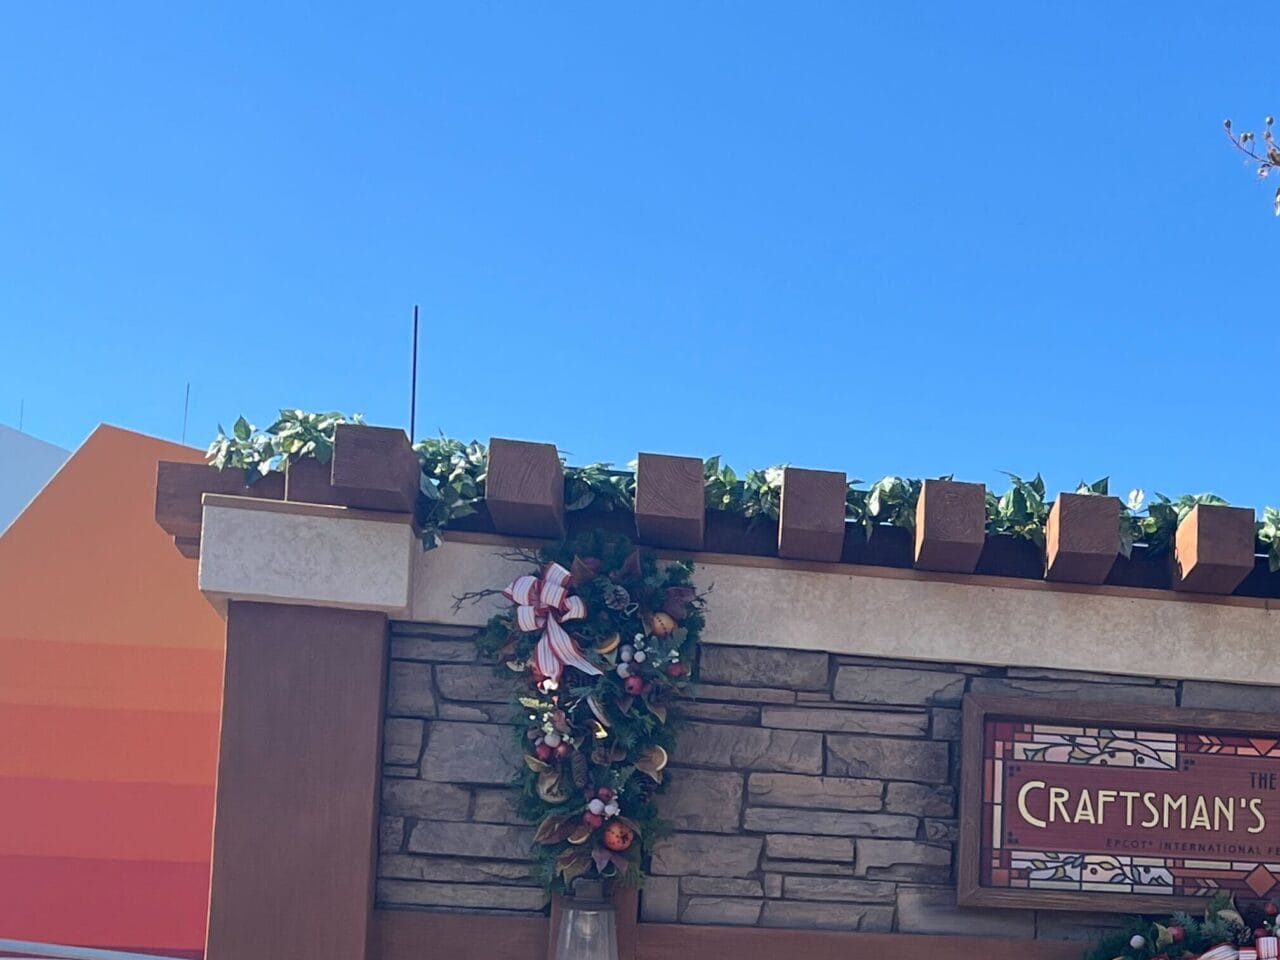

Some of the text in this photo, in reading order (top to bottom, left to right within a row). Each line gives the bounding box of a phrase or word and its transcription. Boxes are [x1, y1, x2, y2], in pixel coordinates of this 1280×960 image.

[1249, 772, 1277, 790] THE
[1017, 780, 1266, 834] CRAFTSMAN'S
[1159, 841, 1261, 855] INTERNATIONAL
